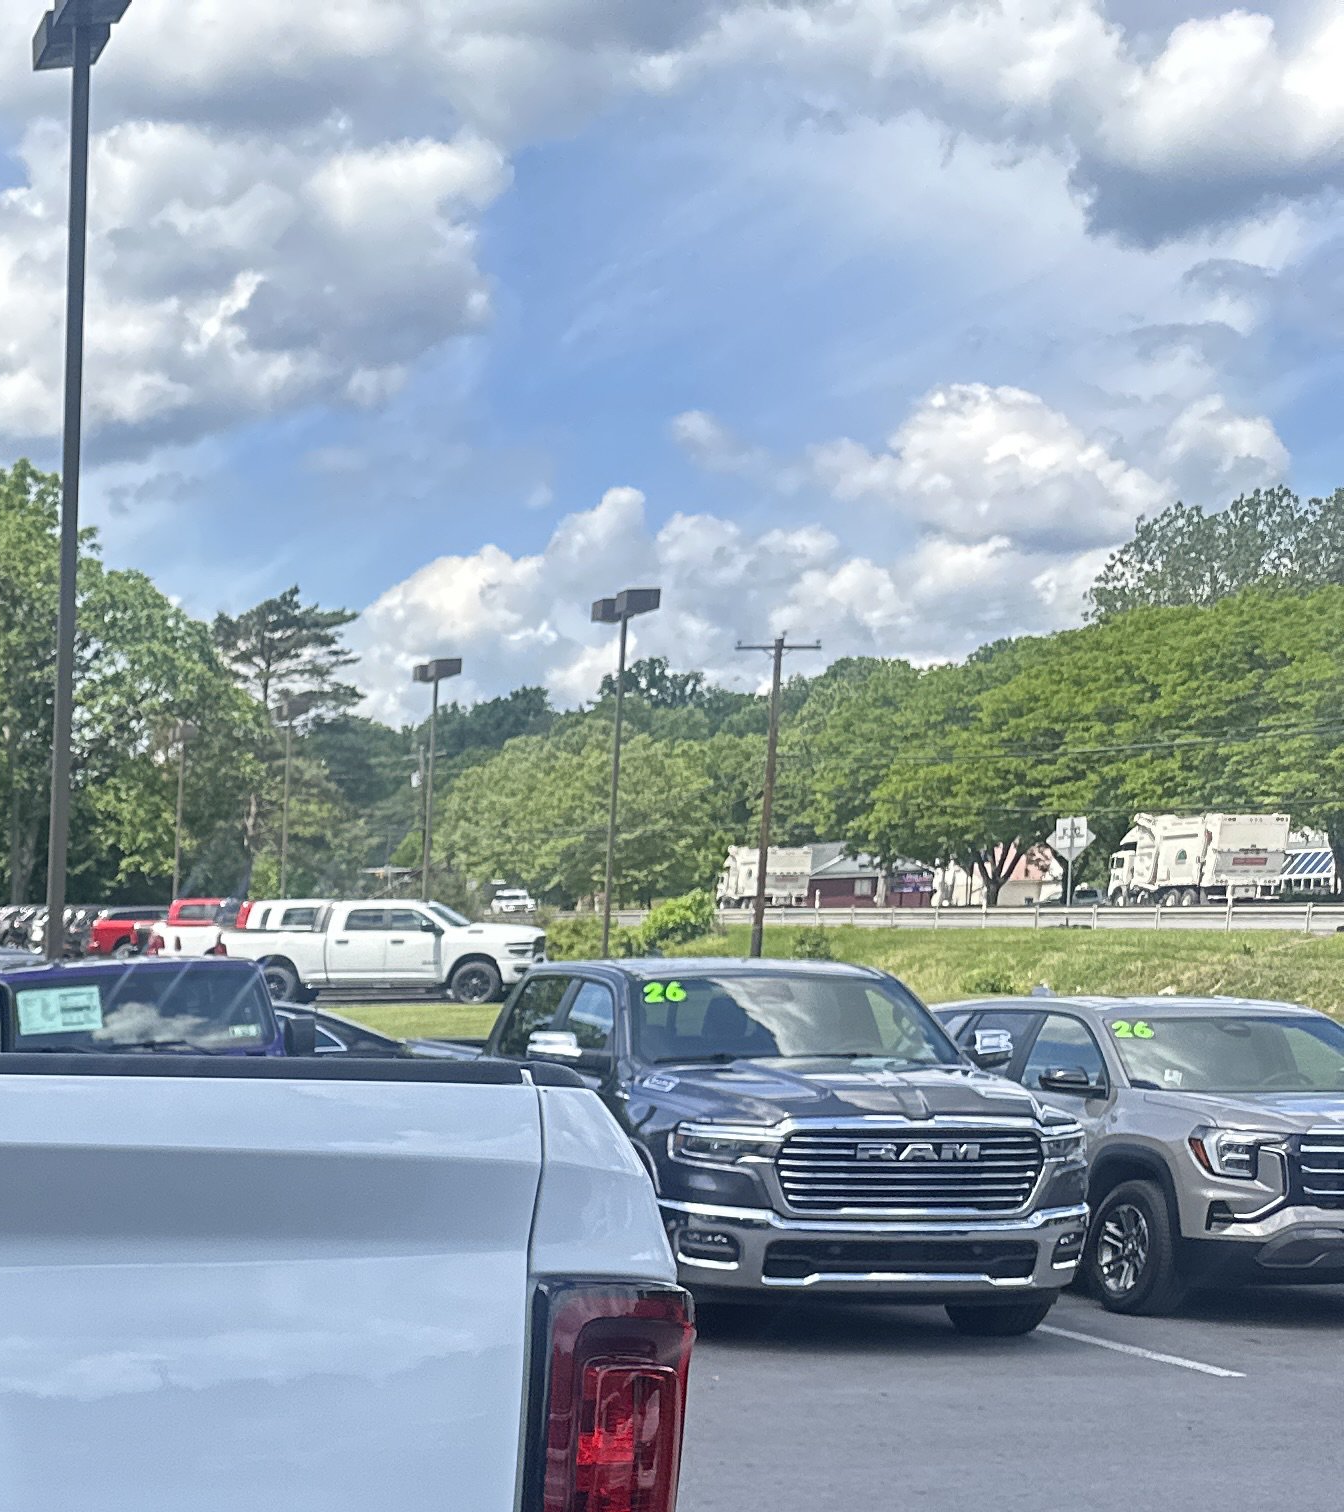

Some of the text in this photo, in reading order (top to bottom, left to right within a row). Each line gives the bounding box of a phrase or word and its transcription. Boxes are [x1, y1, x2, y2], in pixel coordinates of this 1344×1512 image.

[643, 981, 687, 1004] 26
[1111, 1020, 1155, 1038] 26
[856, 1143, 980, 1160] RAM
